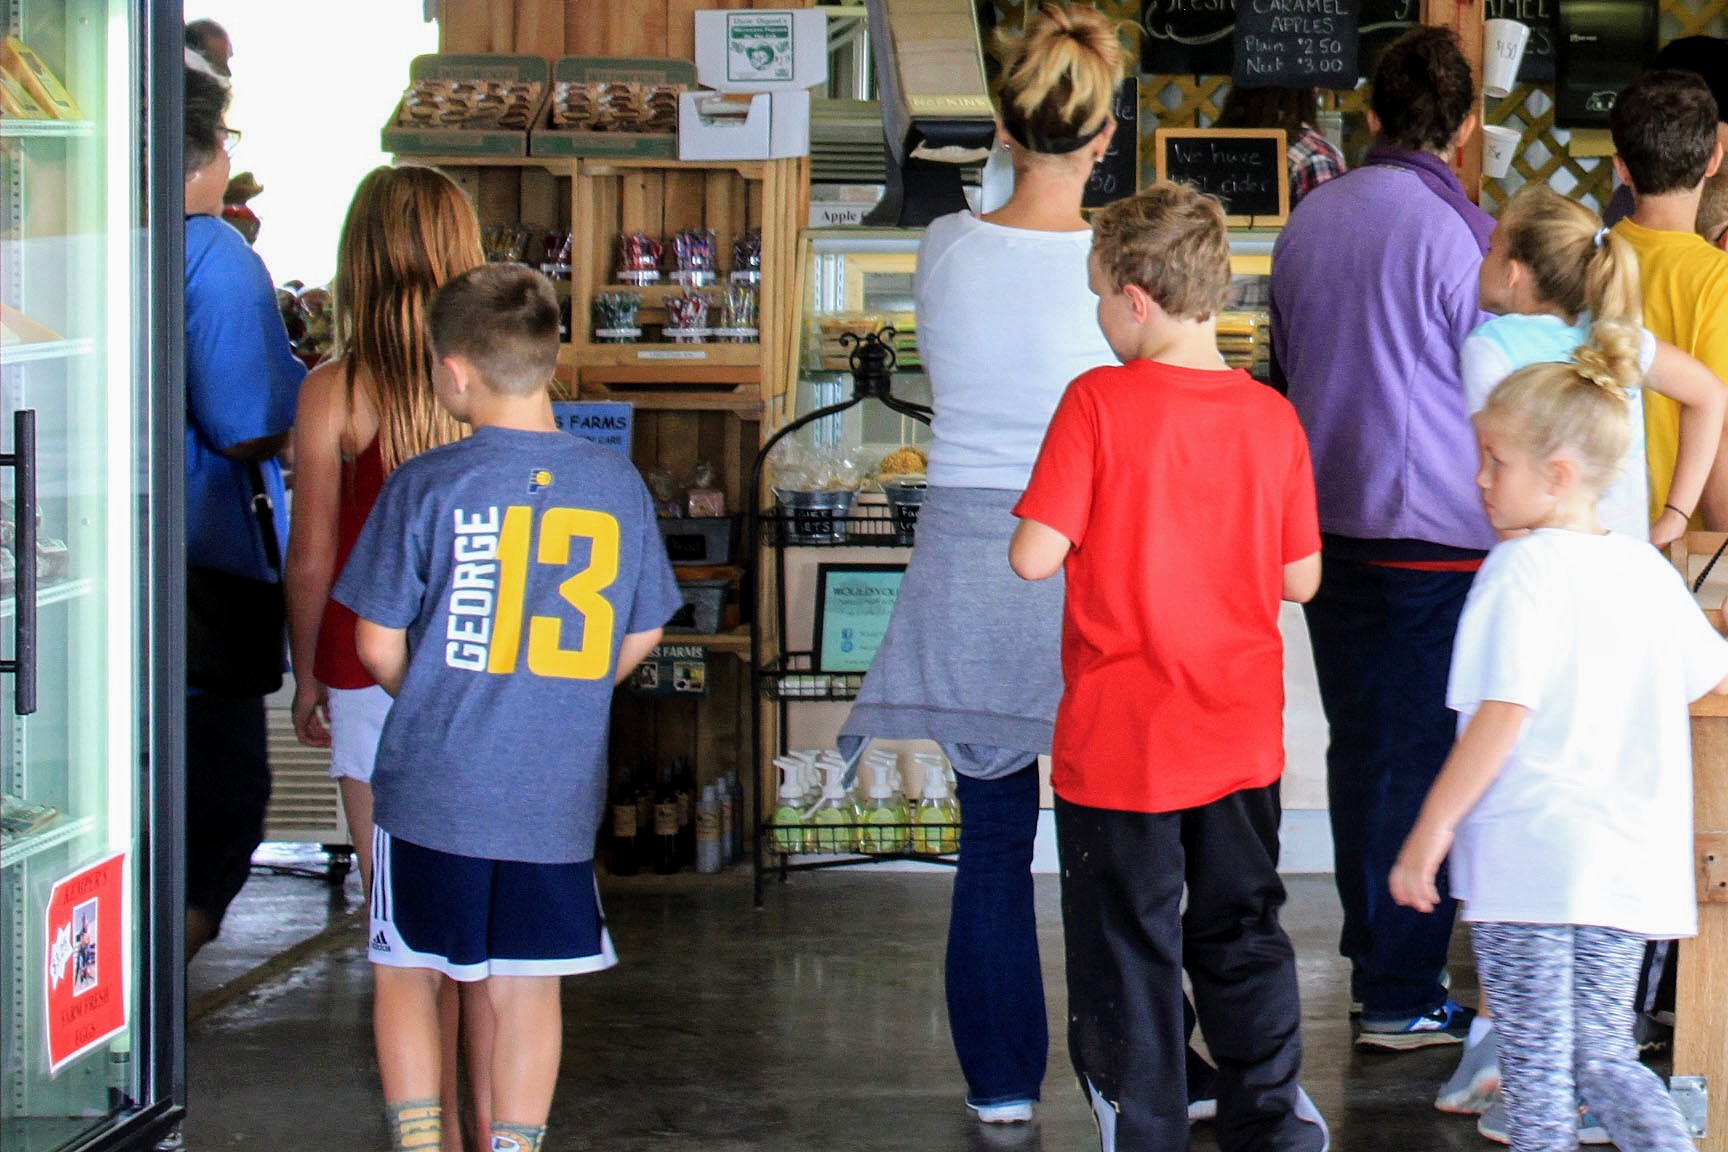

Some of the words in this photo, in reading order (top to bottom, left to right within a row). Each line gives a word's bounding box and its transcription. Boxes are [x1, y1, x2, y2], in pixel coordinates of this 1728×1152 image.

[1270, 16, 1334, 33] APPLES
[1246, 38, 1285, 52] Plain
[1246, 59, 1283, 74] Nut
[1174, 143, 1201, 164] We
[1210, 143, 1263, 165] have
[1221, 177, 1267, 194] cider
[822, 210, 857, 224] Apple
[570, 415, 627, 430] FARMS
[446, 506, 499, 672] GEORGE
[487, 505, 620, 680] 13
[663, 645, 704, 659] FARMS
